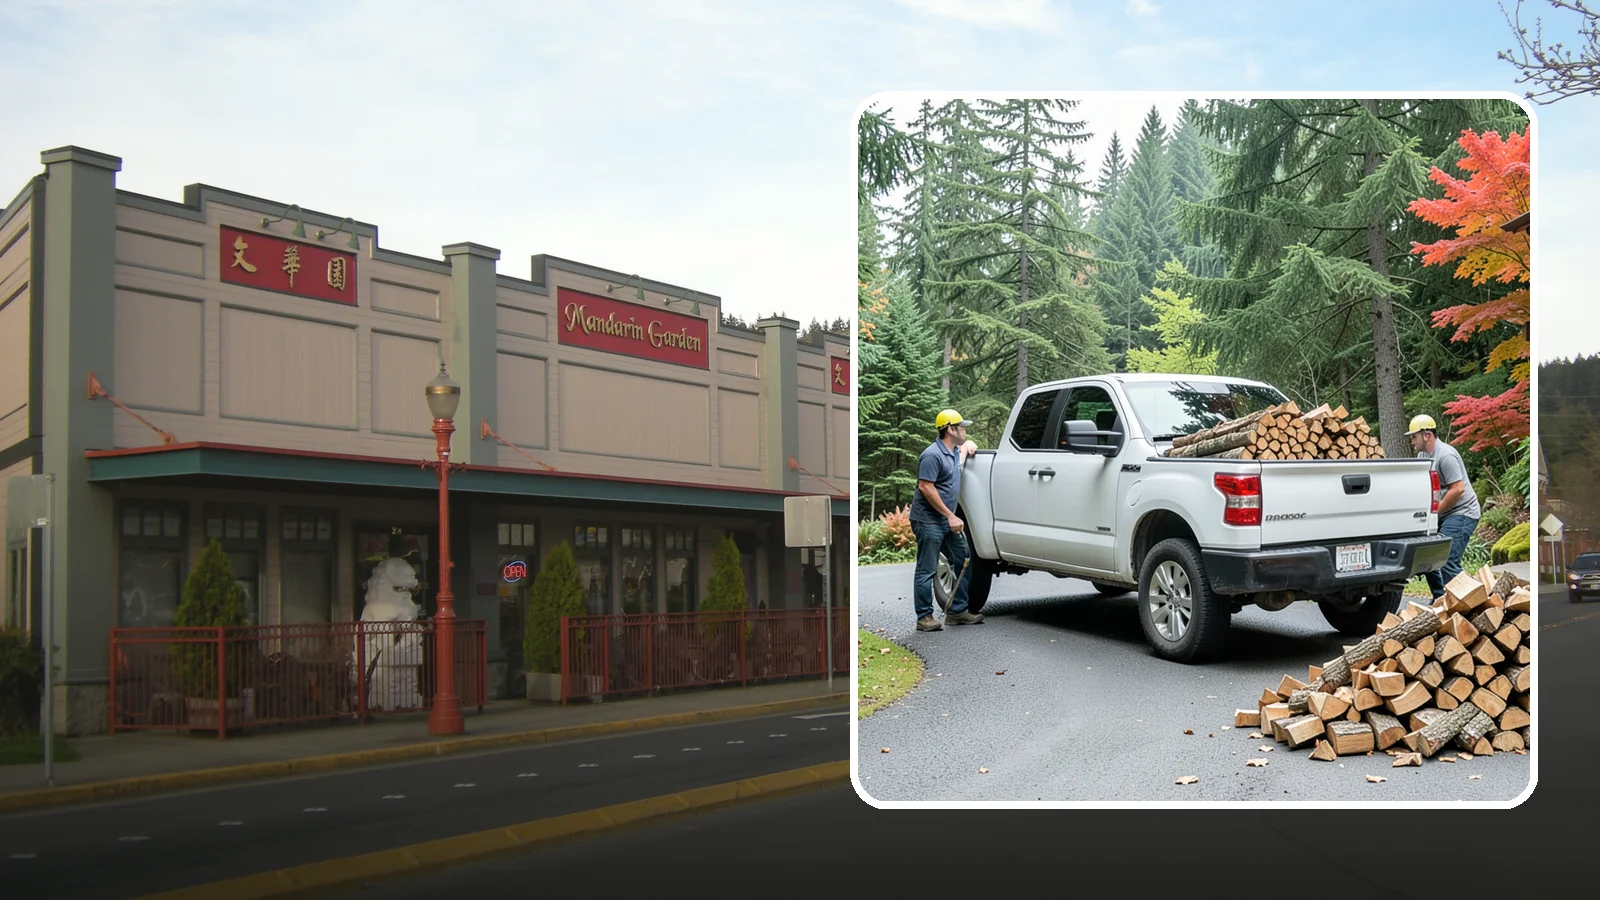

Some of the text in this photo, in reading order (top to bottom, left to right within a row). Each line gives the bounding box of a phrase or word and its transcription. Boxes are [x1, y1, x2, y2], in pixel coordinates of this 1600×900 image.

[230, 235, 346, 291] 文華園
[564, 302, 701, 352] Mandarin Garden
[503, 565, 527, 578] OPEN
